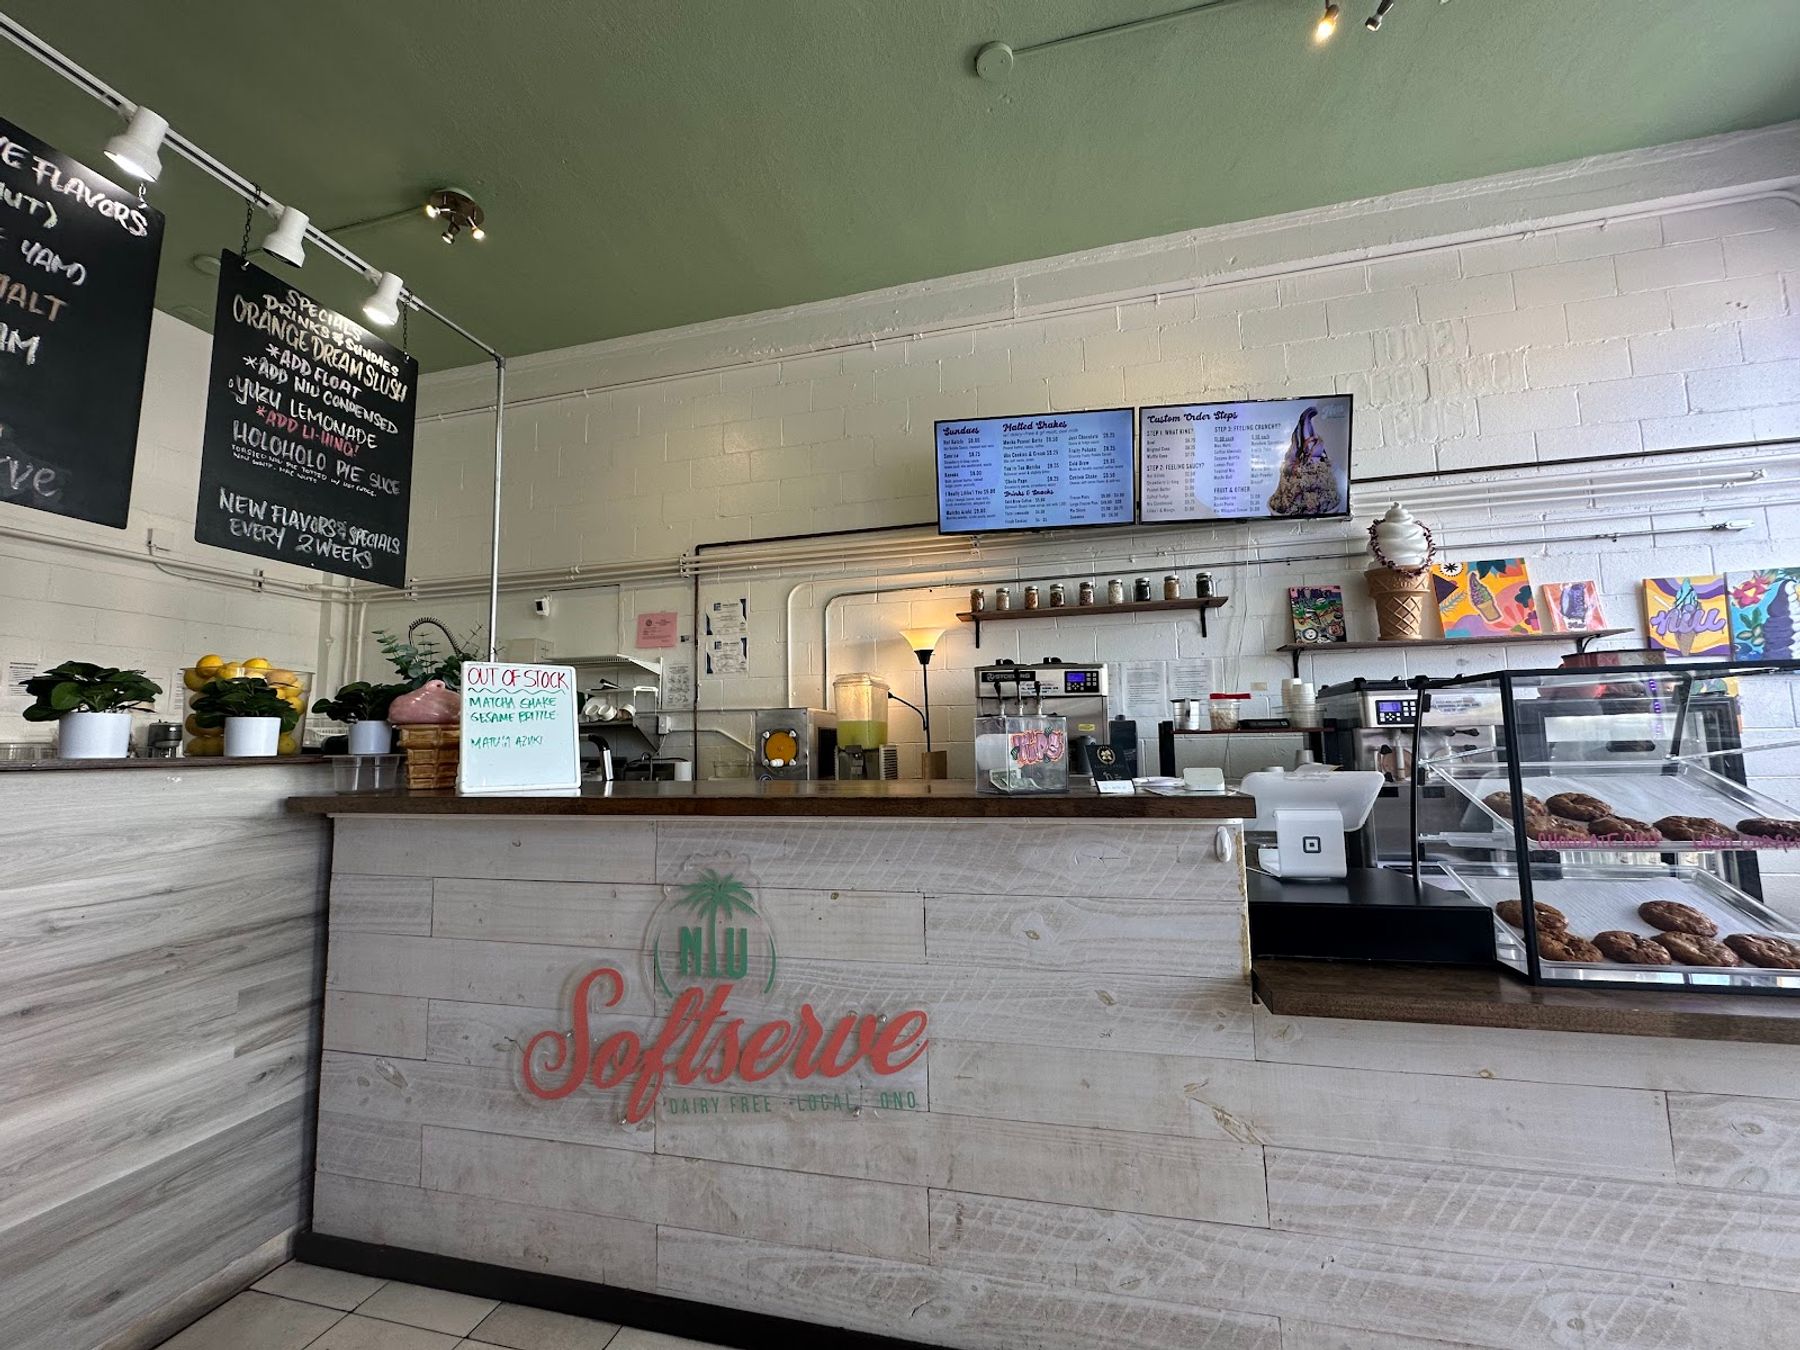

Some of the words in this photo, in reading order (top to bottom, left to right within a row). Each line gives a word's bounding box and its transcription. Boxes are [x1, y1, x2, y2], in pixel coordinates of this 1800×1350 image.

[31, 155, 148, 238] FLAVORS
[263, 293, 329, 339] DRINKS
[286, 289, 363, 342] SPECIALS
[233, 293, 310, 351] ORANGE
[311, 335, 363, 381] DREAM
[363, 364, 408, 403] SLUSH
[294, 376, 320, 397] NIU
[323, 390, 398, 434] CONDENSED
[314, 367, 363, 399] FLOAT
[290, 399, 378, 449] LEMONADE
[943, 426, 979, 436] Sundaes
[1003, 422, 1033, 431] Malted
[1036, 420, 1067, 429] Shakes
[1147, 414, 1180, 423] Custom
[1184, 412, 1210, 421] Order
[1214, 411, 1238, 421] Steps
[232, 419, 327, 470] HOLOHOLO
[336, 459, 365, 483] PIE
[369, 472, 401, 496] SLICE
[219, 487, 268, 521] NEW
[270, 504, 336, 538] FLAVORS
[347, 526, 400, 555] SPECIALS
[229, 517, 287, 550] EVERY
[295, 534, 313, 554] 2
[316, 539, 374, 570] WEEKS
[468, 667, 499, 686] OUT
[502, 669, 521, 687] OF
[524, 669, 569, 690] STOCK
[469, 697, 515, 709] MATCHA
[520, 697, 557, 709] SHAKE
[471, 712, 515, 724] SESAME
[680, 926, 748, 979] NIU
[523, 967, 929, 1124] Softserve
[669, 1097, 719, 1115] DAIRY
[730, 1097, 772, 1114] FREE
[797, 1093, 854, 1112] LOCAL
[879, 1090, 917, 1110] ONO
